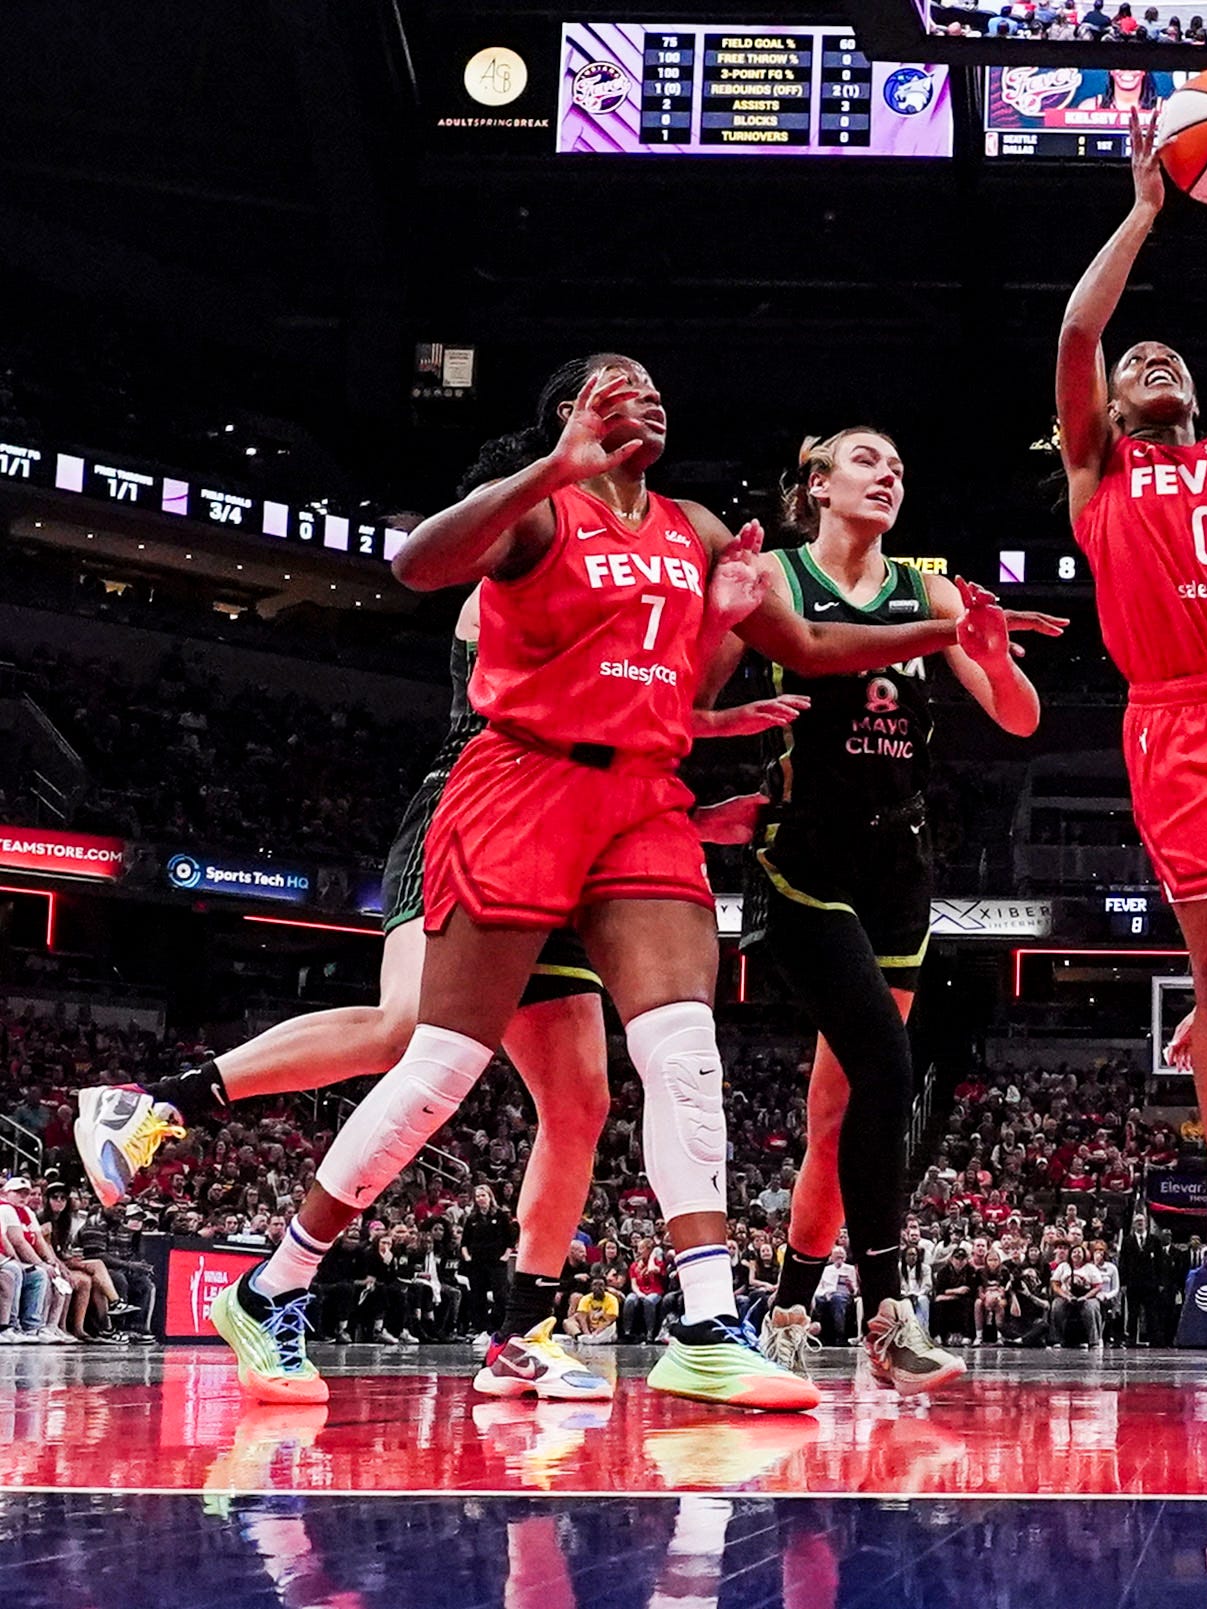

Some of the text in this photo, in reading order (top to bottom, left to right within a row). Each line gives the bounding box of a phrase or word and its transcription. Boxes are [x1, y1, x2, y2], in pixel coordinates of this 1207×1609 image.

[722, 38, 752, 48] FIELD
[754, 38, 784, 48] GOAL
[786, 40, 796, 49] %
[658, 53, 680, 63] 100
[718, 54, 746, 64] FREE
[748, 54, 788, 64] THROW
[789, 55, 798, 64] %
[658, 68, 680, 78] 100
[720, 70, 762, 79] 3-POINT
[765, 70, 783, 80] FG
[784, 70, 794, 80] %
[711, 84, 771, 95] REBOUNDS
[773, 84, 802, 96] (OFF)
[832, 86, 841, 96] 2
[662, 100, 850, 112] 2 ASSISTS 3
[437, 118, 549, 128] ADULTSPRINGBREAK
[734, 116, 778, 126] BLOCKS
[662, 130, 668, 140] 1
[722, 131, 788, 142] TURNOVERS
[108, 479, 138, 500] 1/1
[210, 502, 242, 524] 3/4
[300, 523, 312, 540] 0
[360, 536, 372, 554] 2
[584, 554, 703, 598] FEVER
[1058, 556, 1076, 579] 8
[640, 594, 666, 651] 7
[851, 717, 909, 735] MAYO
[845, 737, 914, 759] CLINIC
[206, 866, 310, 890] Sports Tech HQ
[980, 906, 1050, 920] XIBER
[1106, 898, 1147, 912] FEVER
[1132, 917, 1142, 934] 8
